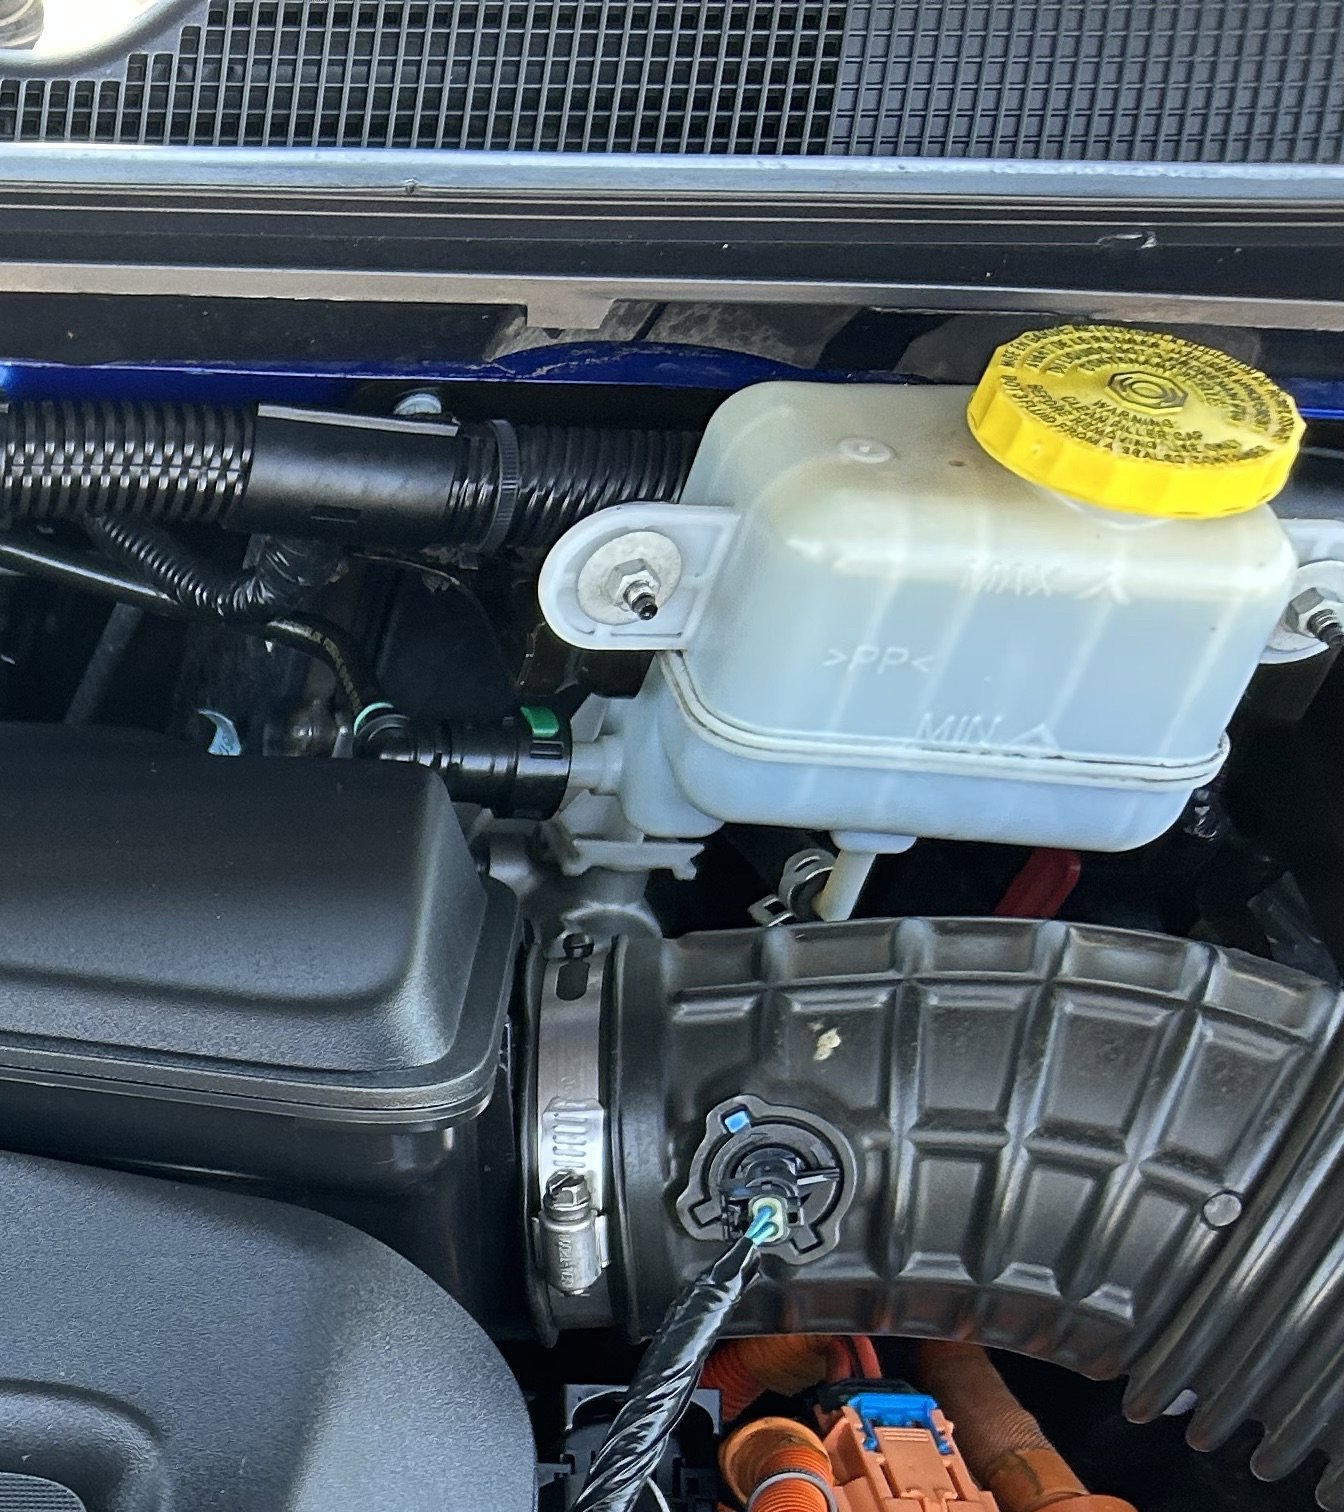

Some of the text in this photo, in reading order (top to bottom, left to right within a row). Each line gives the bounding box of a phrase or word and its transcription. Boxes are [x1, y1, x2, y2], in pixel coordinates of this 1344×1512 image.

[1026, 383, 1075, 420] BEFORE
[1060, 395, 1107, 424] CLEAN
[1092, 399, 1175, 428] WARNING
[912, 713, 1004, 748] MIN
